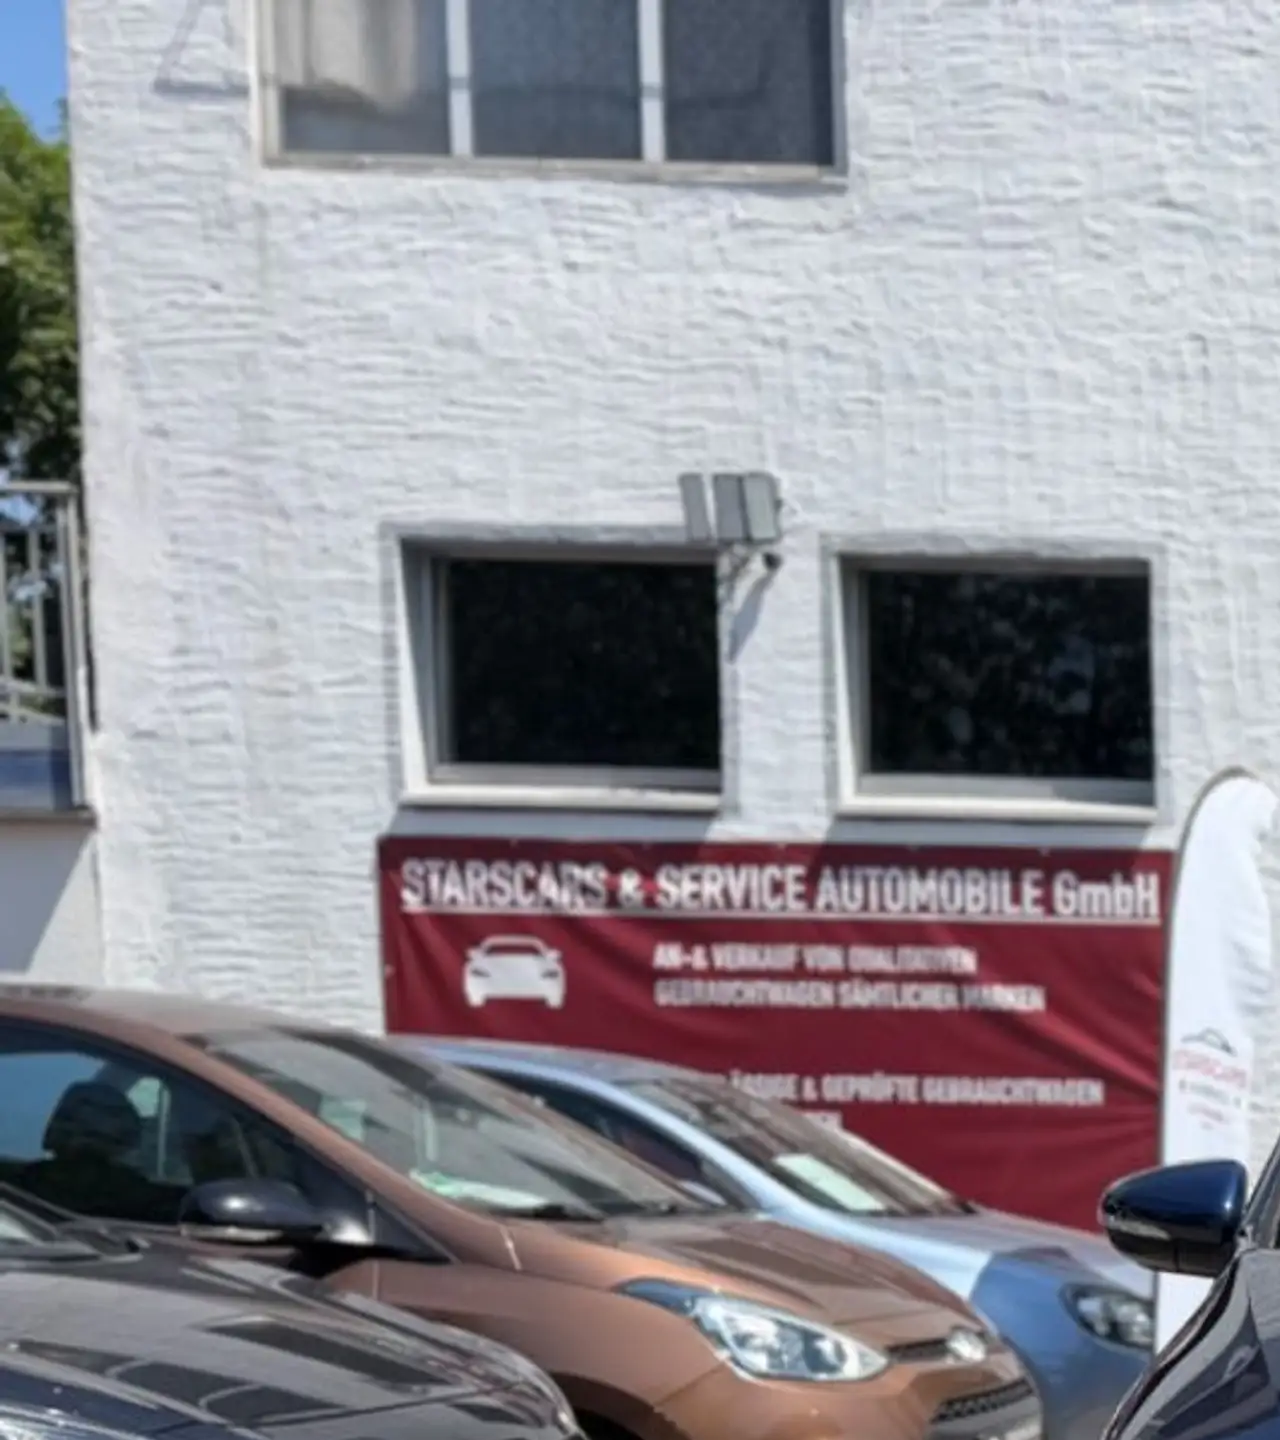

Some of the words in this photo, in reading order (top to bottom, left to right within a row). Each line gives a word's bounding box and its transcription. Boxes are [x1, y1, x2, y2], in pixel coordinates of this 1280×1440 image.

[401, 858, 607, 908] STARSCARS
[618, 868, 643, 905] &
[656, 863, 807, 910] SERVICE
[815, 866, 1046, 916] AUTOMOBILE
[1052, 870, 1161, 918] GmbH
